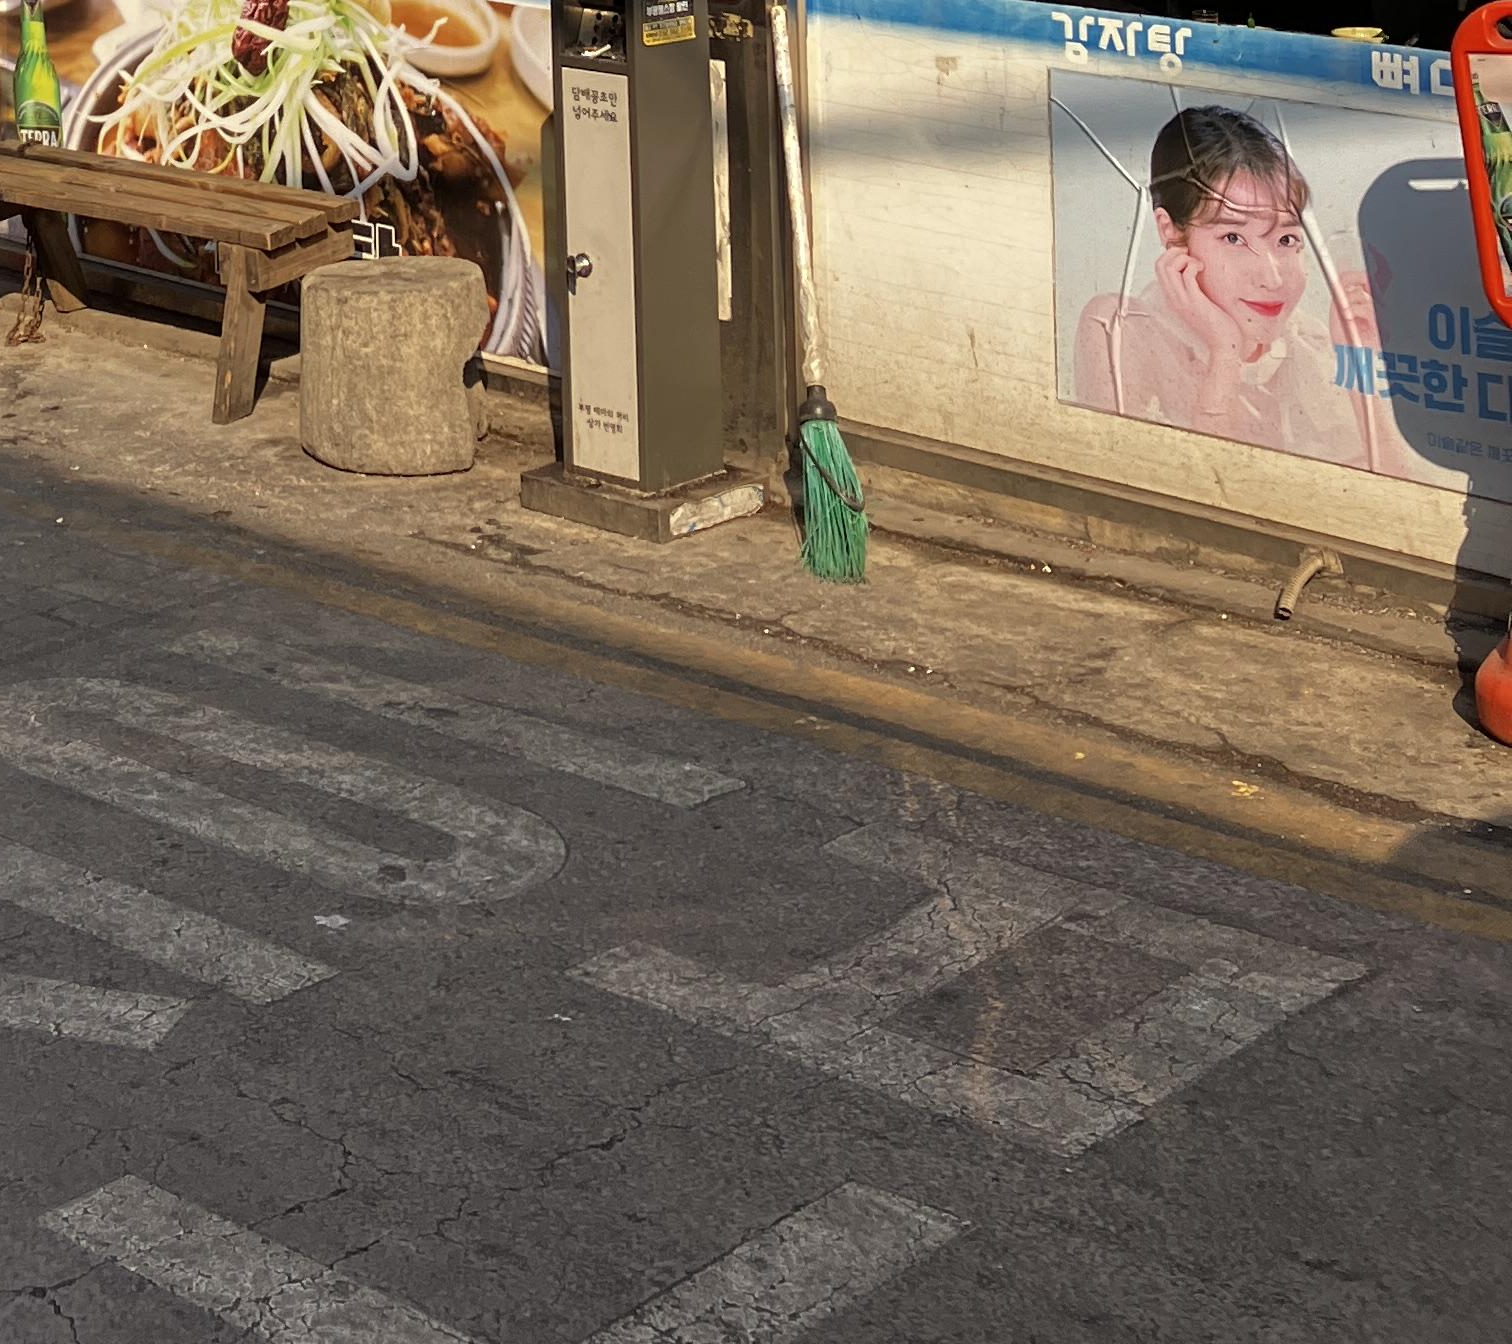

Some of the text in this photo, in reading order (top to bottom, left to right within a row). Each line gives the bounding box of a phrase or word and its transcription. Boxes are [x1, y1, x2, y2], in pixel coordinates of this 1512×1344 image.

[1051, 11, 1193, 76] 감자탕
[19, 125, 60, 148] TERRA
[1334, 343, 1469, 413] 깨끗한
